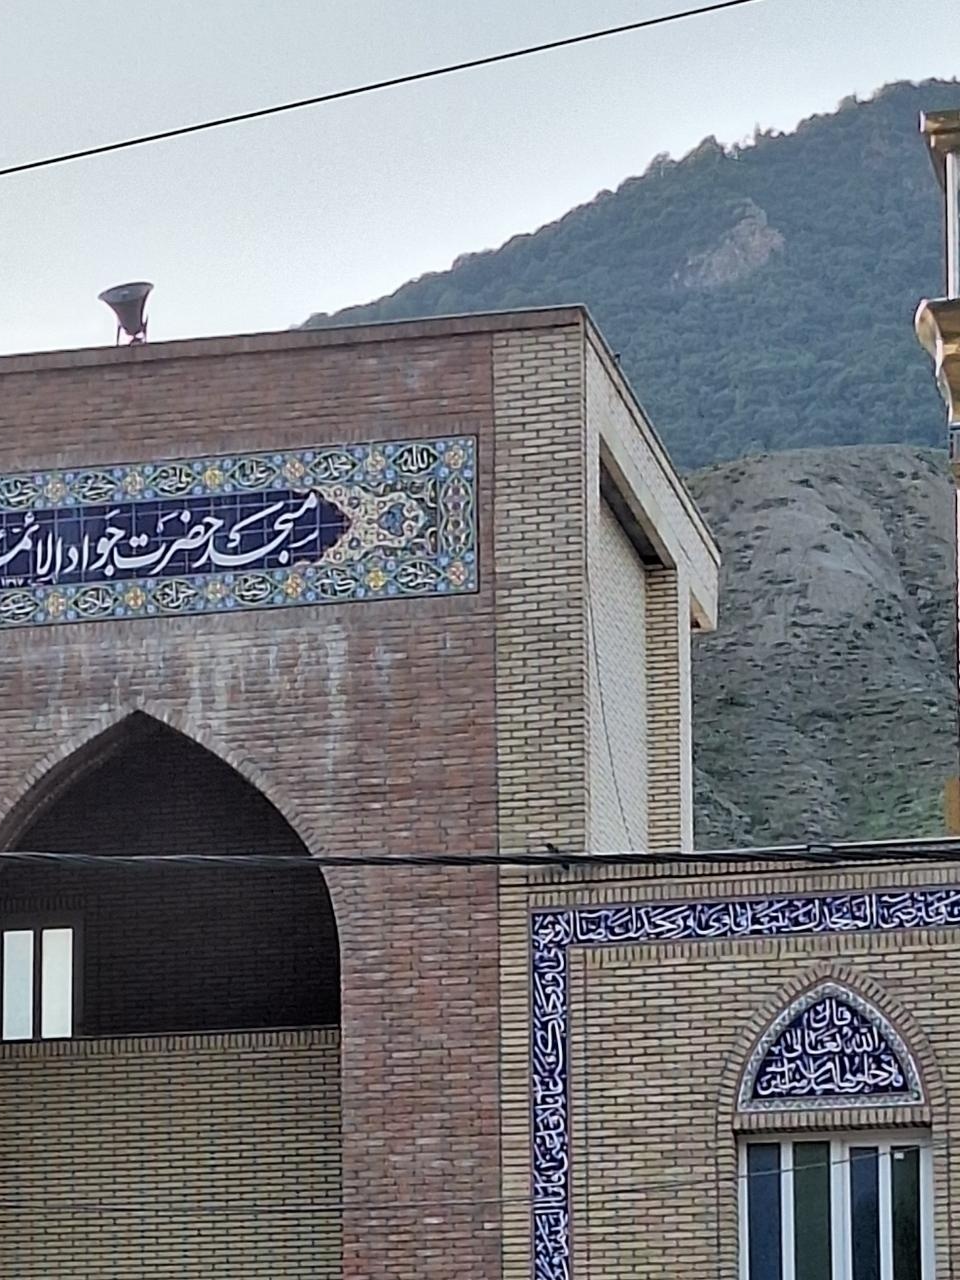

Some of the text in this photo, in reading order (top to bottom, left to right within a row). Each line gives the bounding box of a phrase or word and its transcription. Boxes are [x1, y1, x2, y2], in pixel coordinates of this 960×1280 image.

[63, 511, 126, 577] جواد
[114, 509, 224, 575] حضرت
[193, 492, 318, 568] مسجد
